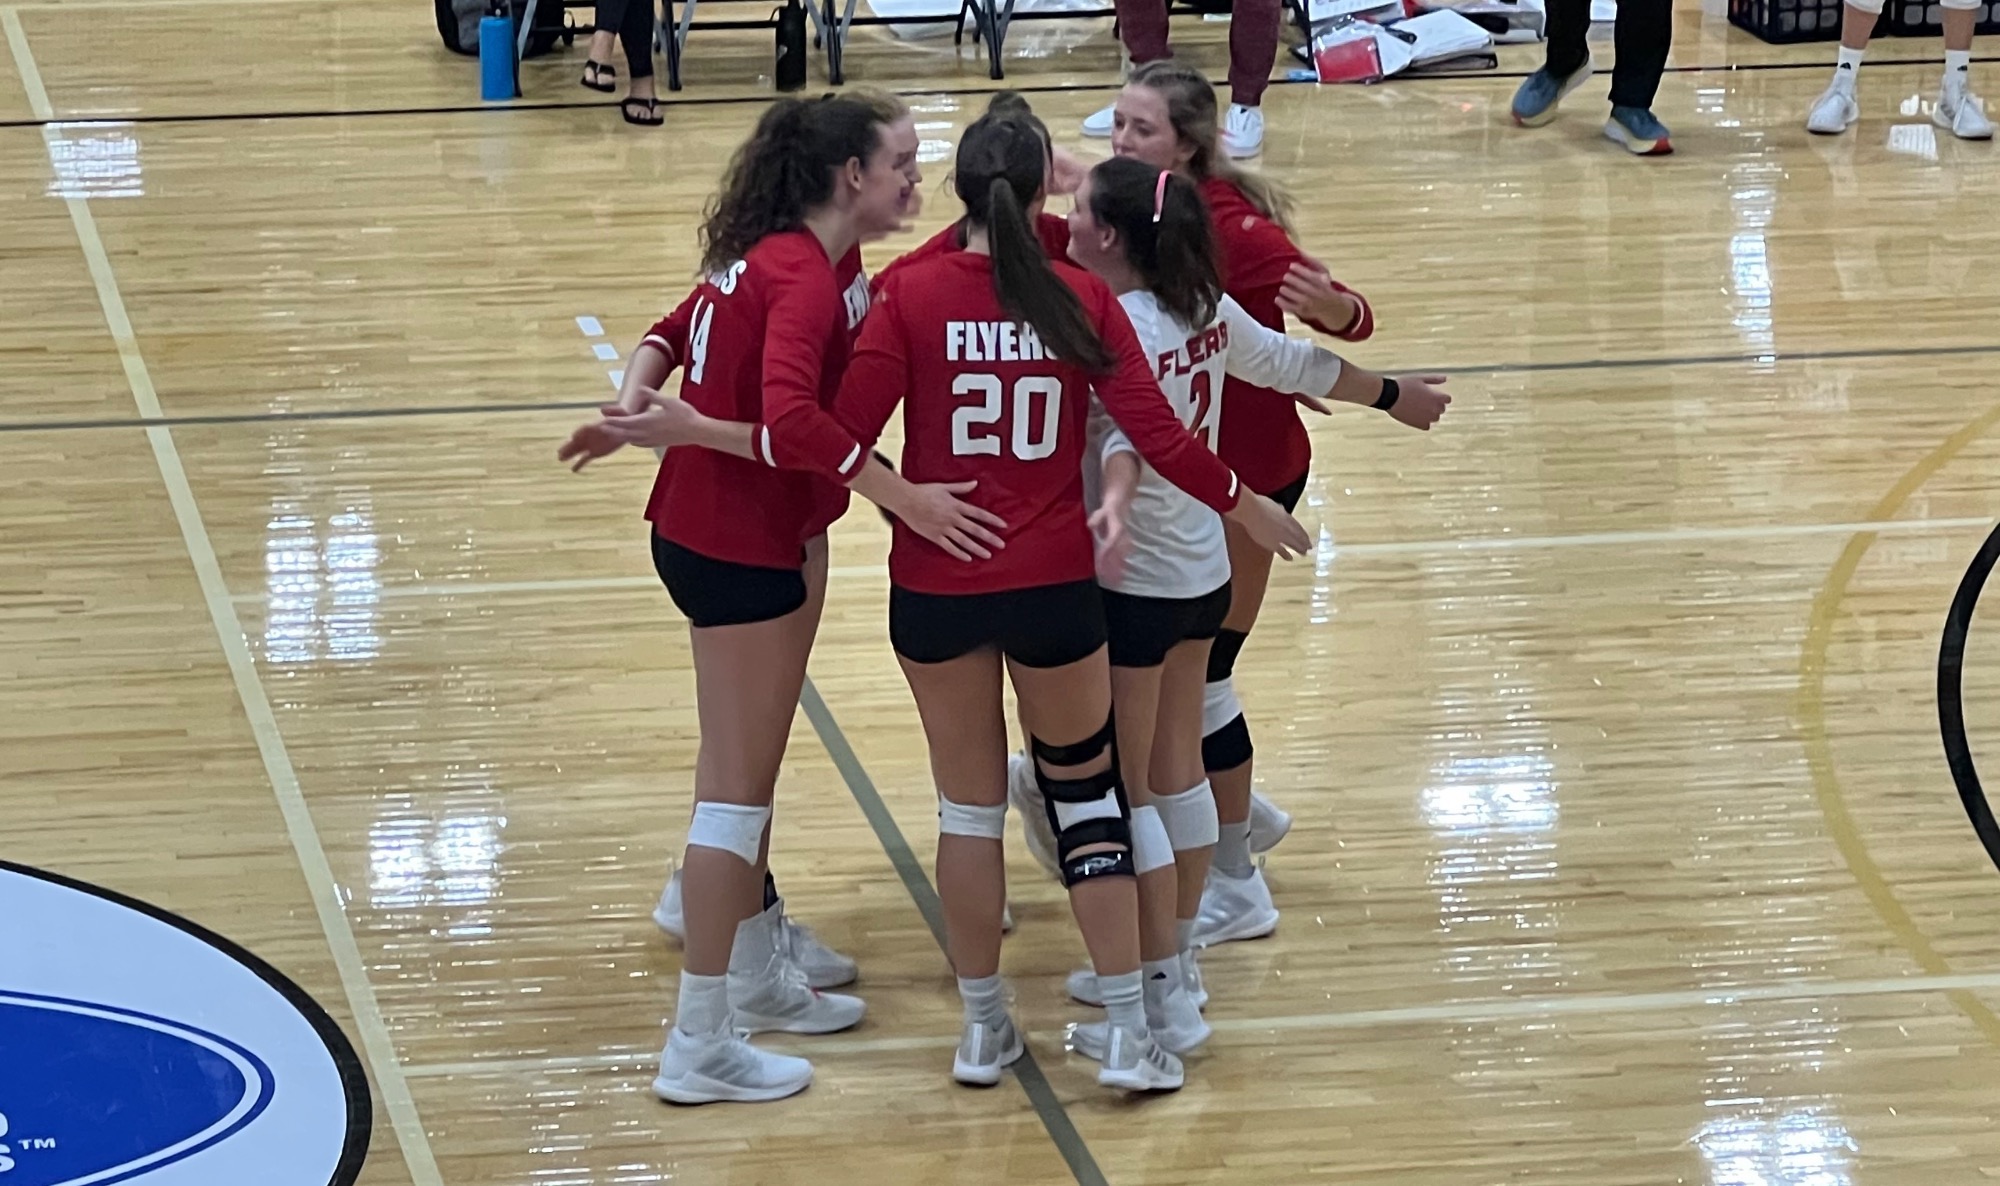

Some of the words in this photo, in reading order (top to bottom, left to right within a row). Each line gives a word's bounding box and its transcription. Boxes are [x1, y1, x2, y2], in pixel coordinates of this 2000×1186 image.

[946, 321, 1059, 361] FLYER
[951, 373, 1062, 460] 20
[18, 1137, 56, 1150] TM
